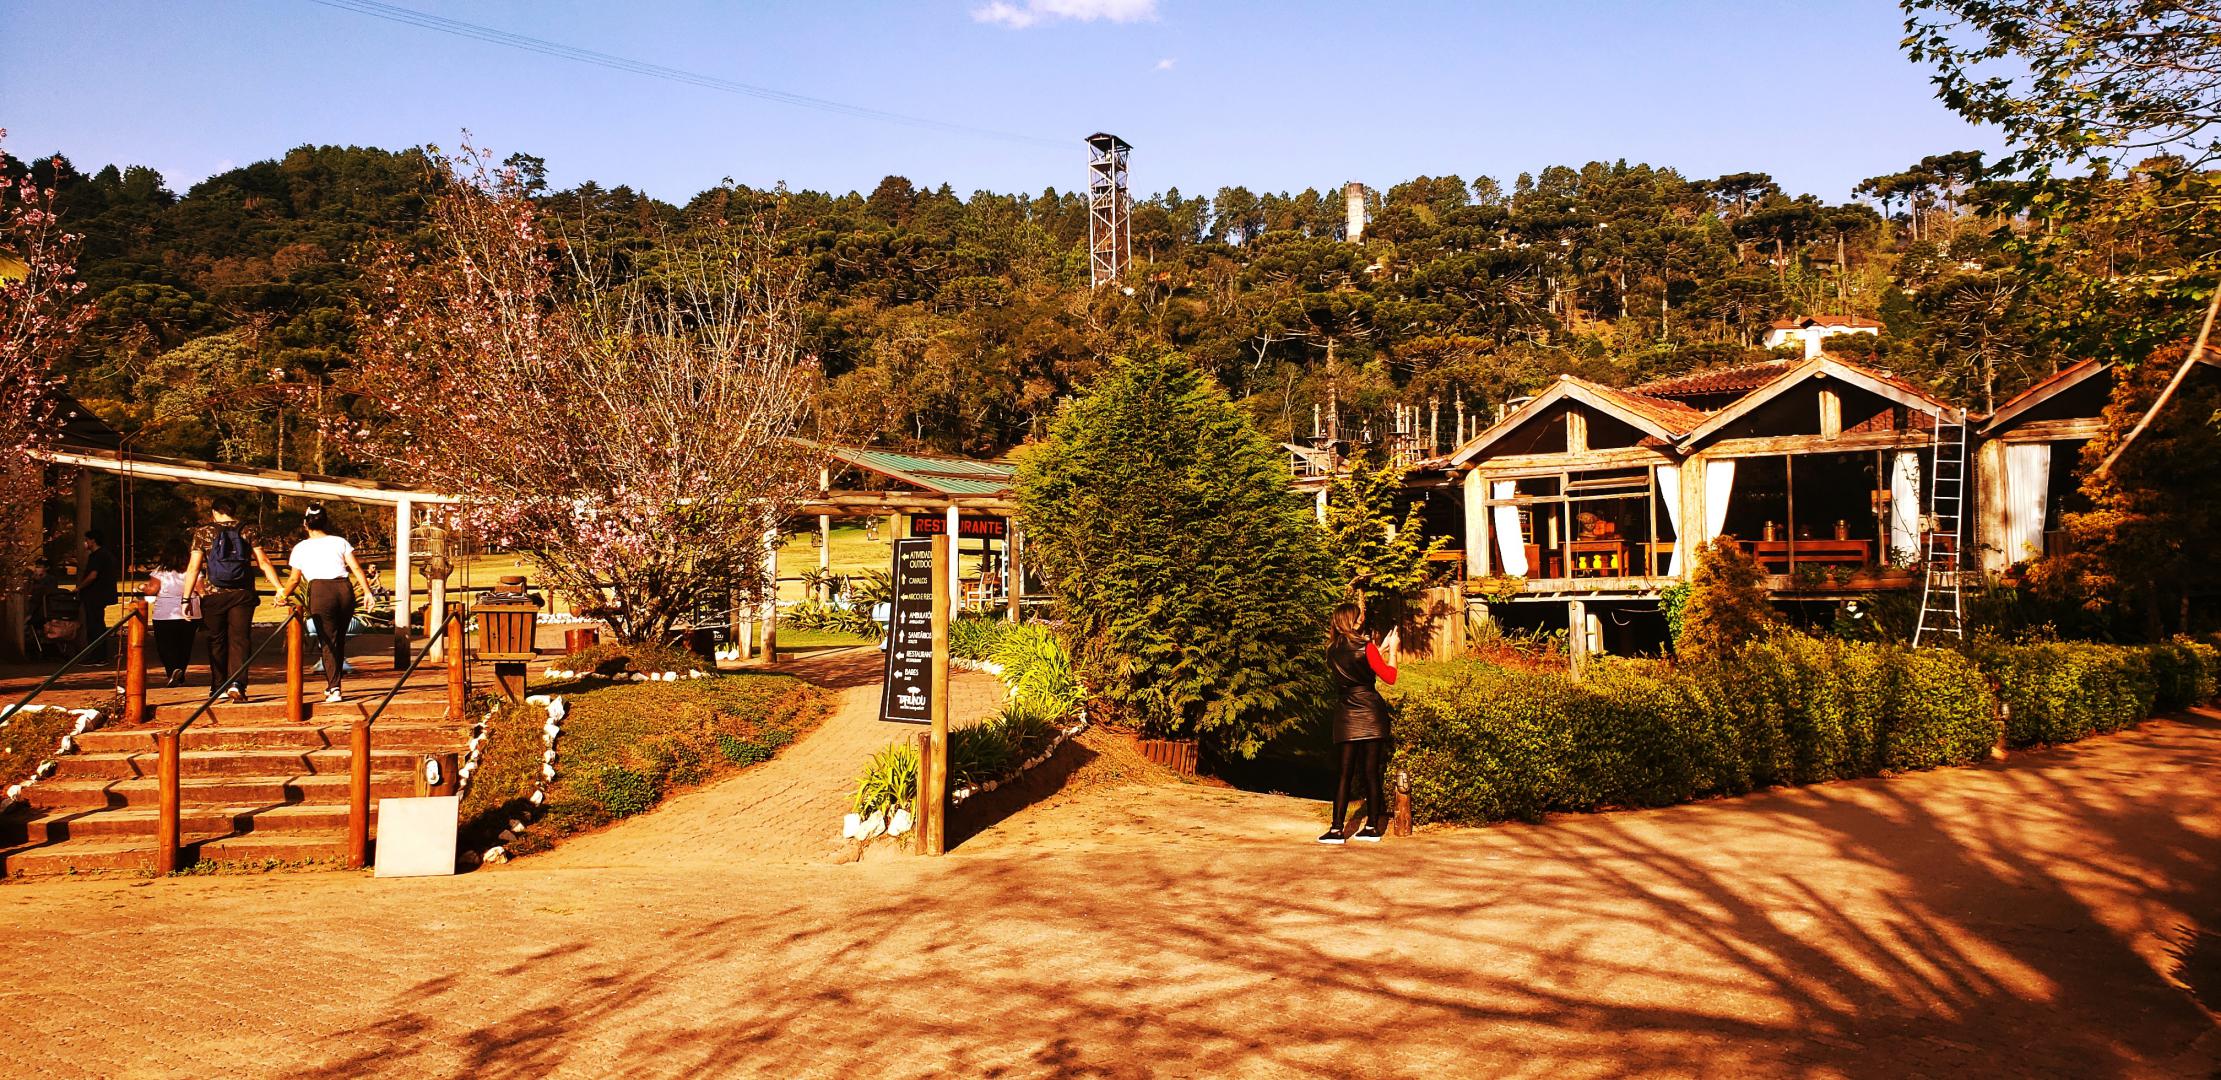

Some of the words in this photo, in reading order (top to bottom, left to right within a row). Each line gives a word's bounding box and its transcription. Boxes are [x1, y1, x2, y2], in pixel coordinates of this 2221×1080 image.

[915, 518, 1003, 535] RESTURANTE
[909, 550, 932, 559] ATIVIDAD
[909, 559, 932, 569] OUTDOO
[905, 650, 932, 658] RESTAURANT
